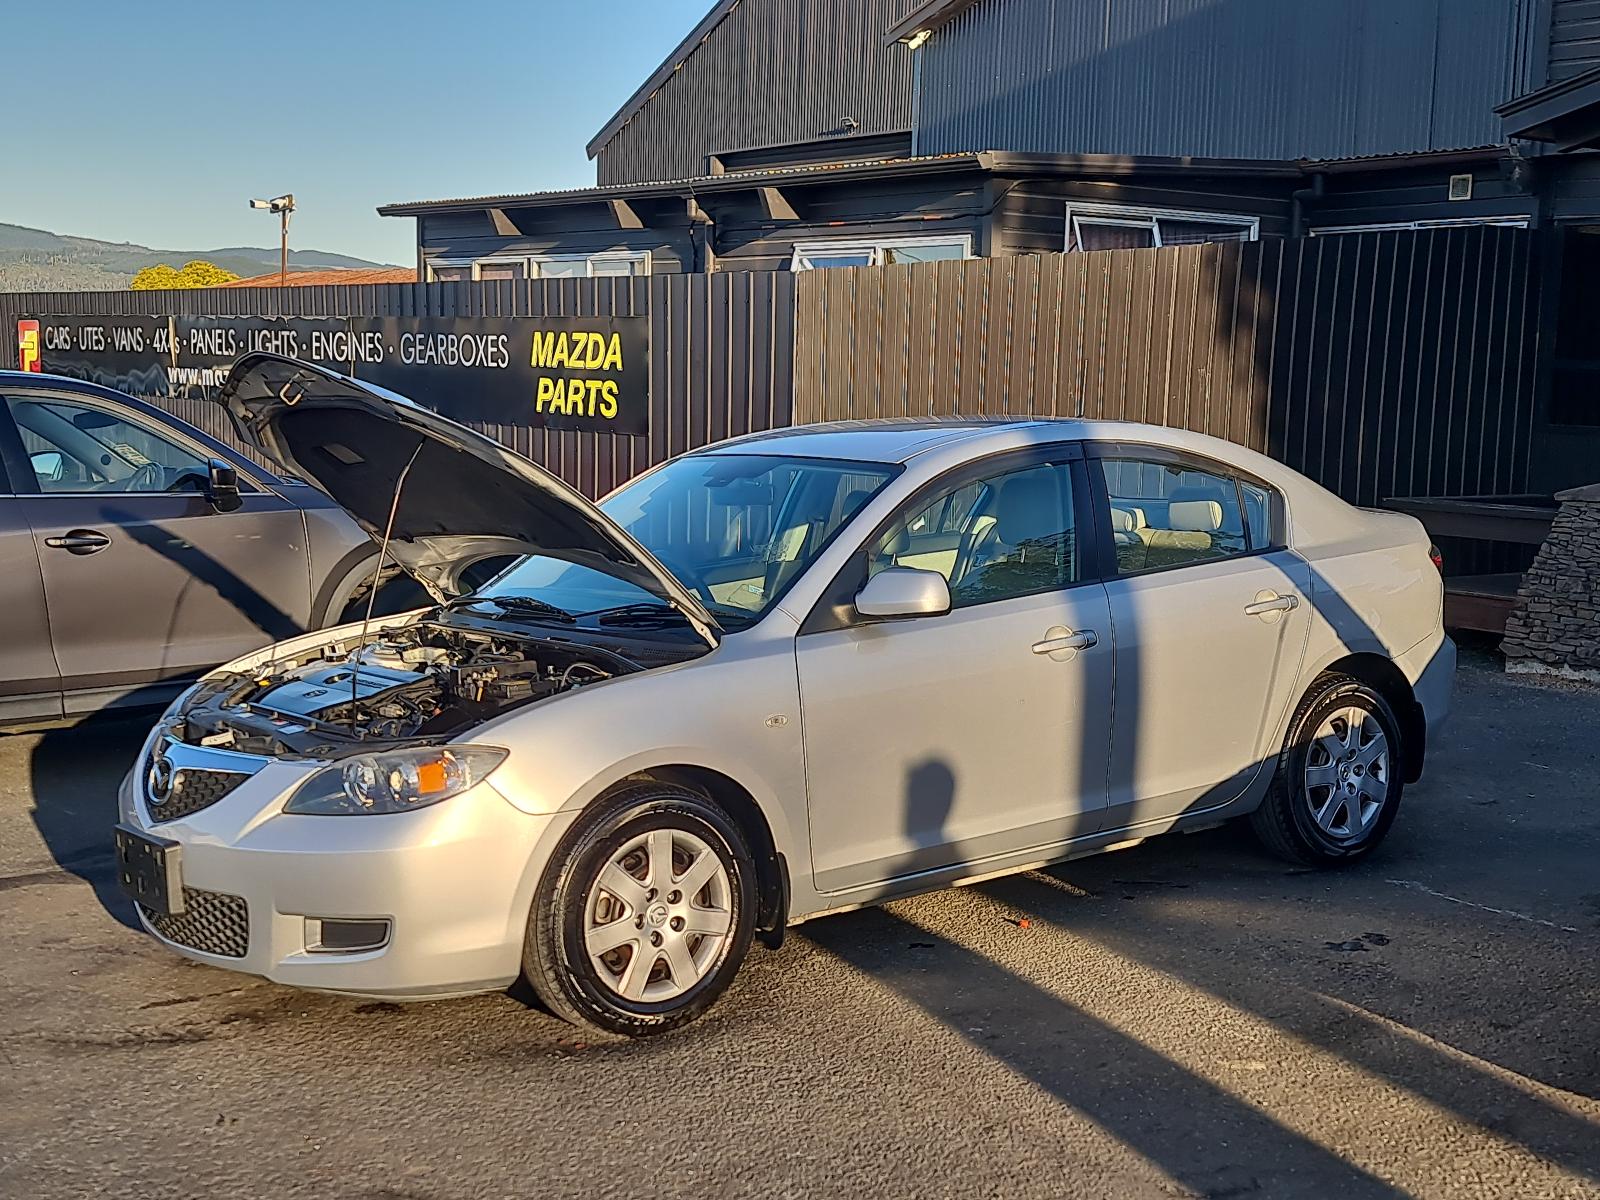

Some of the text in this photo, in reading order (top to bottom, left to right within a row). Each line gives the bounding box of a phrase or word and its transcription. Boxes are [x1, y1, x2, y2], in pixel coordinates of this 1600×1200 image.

[45, 326, 72, 351] CARS
[79, 326, 107, 352] UTES
[113, 327, 144, 353] VANS
[152, 328, 180, 354] 4Xs
[190, 328, 236, 356] PANELS
[312, 331, 384, 363] ENGINES
[400, 332, 509, 367] GEARBOXES
[530, 331, 623, 371] MAZDA
[536, 378, 619, 419] PARTS
